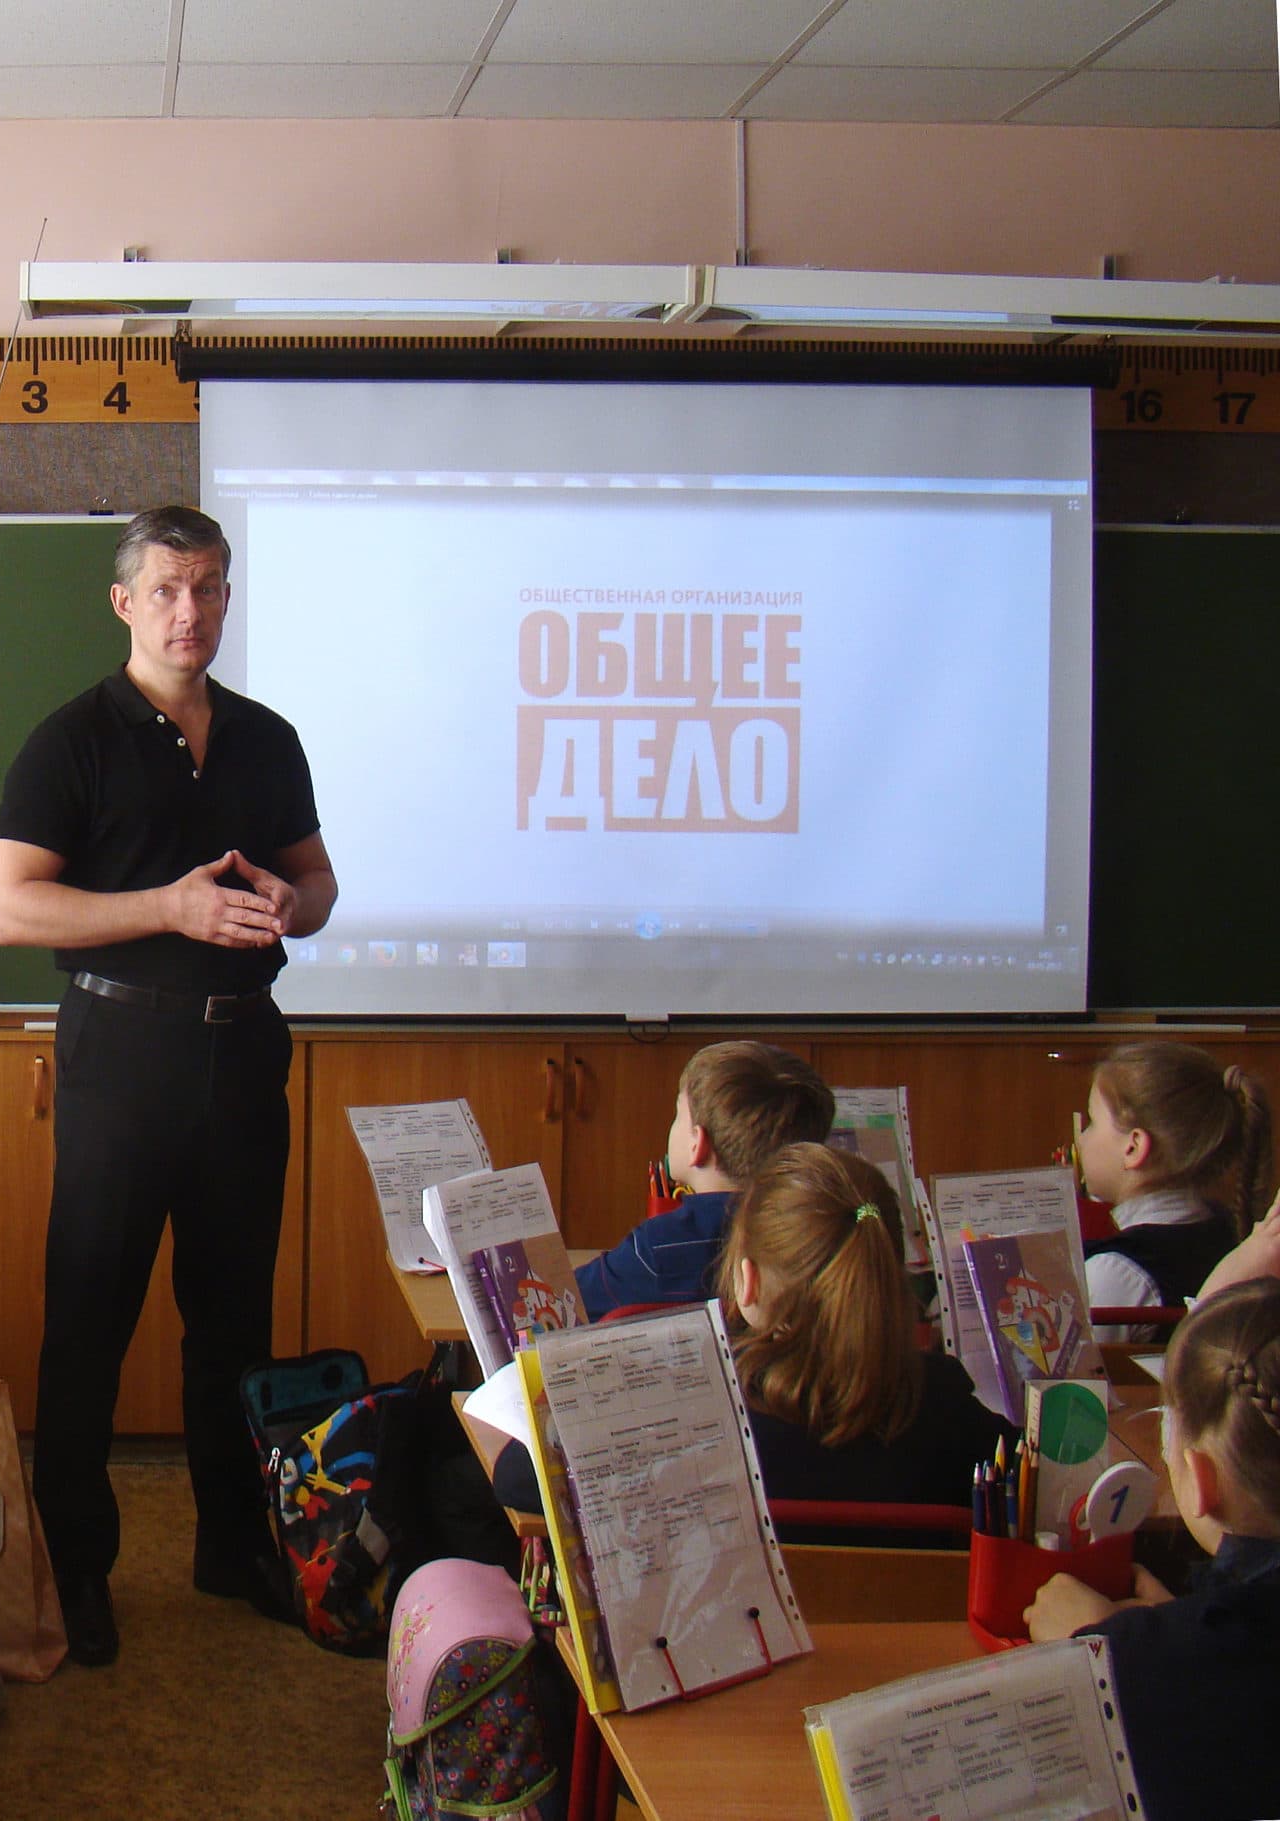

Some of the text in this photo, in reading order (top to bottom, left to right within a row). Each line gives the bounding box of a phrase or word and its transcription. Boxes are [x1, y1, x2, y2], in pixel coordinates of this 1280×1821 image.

[21, 382, 48, 414] 3
[103, 382, 131, 414] 4
[1122, 390, 1256, 425] 16 17
[520, 588, 803, 607] ОБЩЕСТВЕННАЯ ОРГАНИЗАЦИЯ
[518, 610, 802, 702] ОБЩЕЕ
[528, 718, 789, 831] ДЕЛО
[1110, 1485, 1130, 1524] 1
